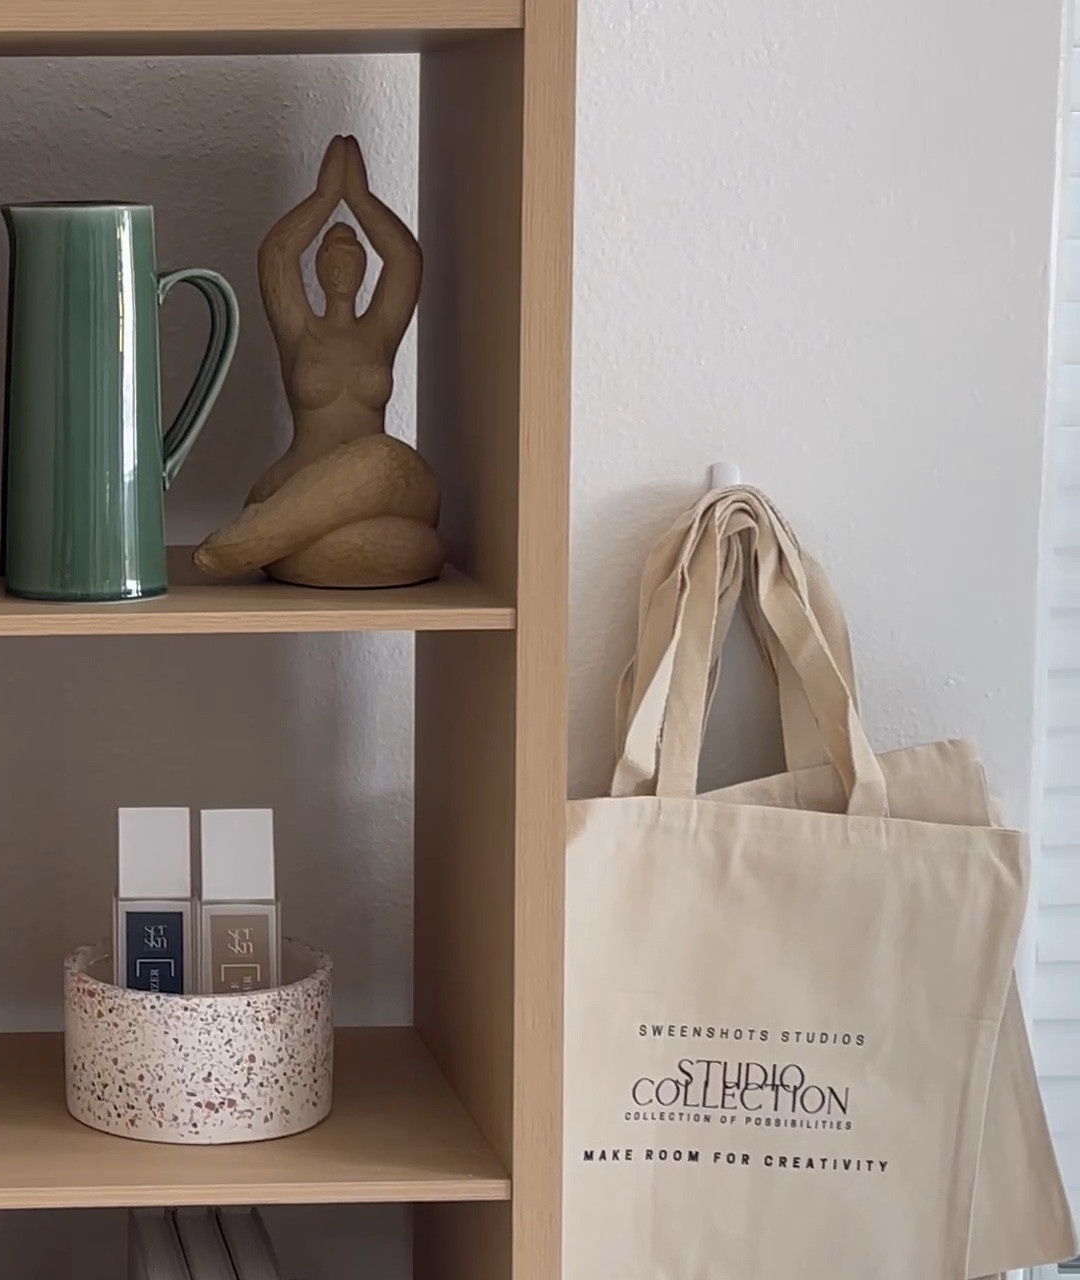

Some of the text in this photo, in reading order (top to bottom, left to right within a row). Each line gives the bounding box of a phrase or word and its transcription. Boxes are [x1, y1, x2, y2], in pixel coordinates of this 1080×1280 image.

[638, 1023, 865, 1047] SWEENSHOTS STUDIOS
[677, 1058, 805, 1092] STUDIO
[631, 1077, 850, 1115] COLLECTION
[624, 1111, 852, 1131] COLLECTION OF POSSIBILITIES
[583, 1148, 888, 1172] MAKE ROOM FOR CREATIVITY
